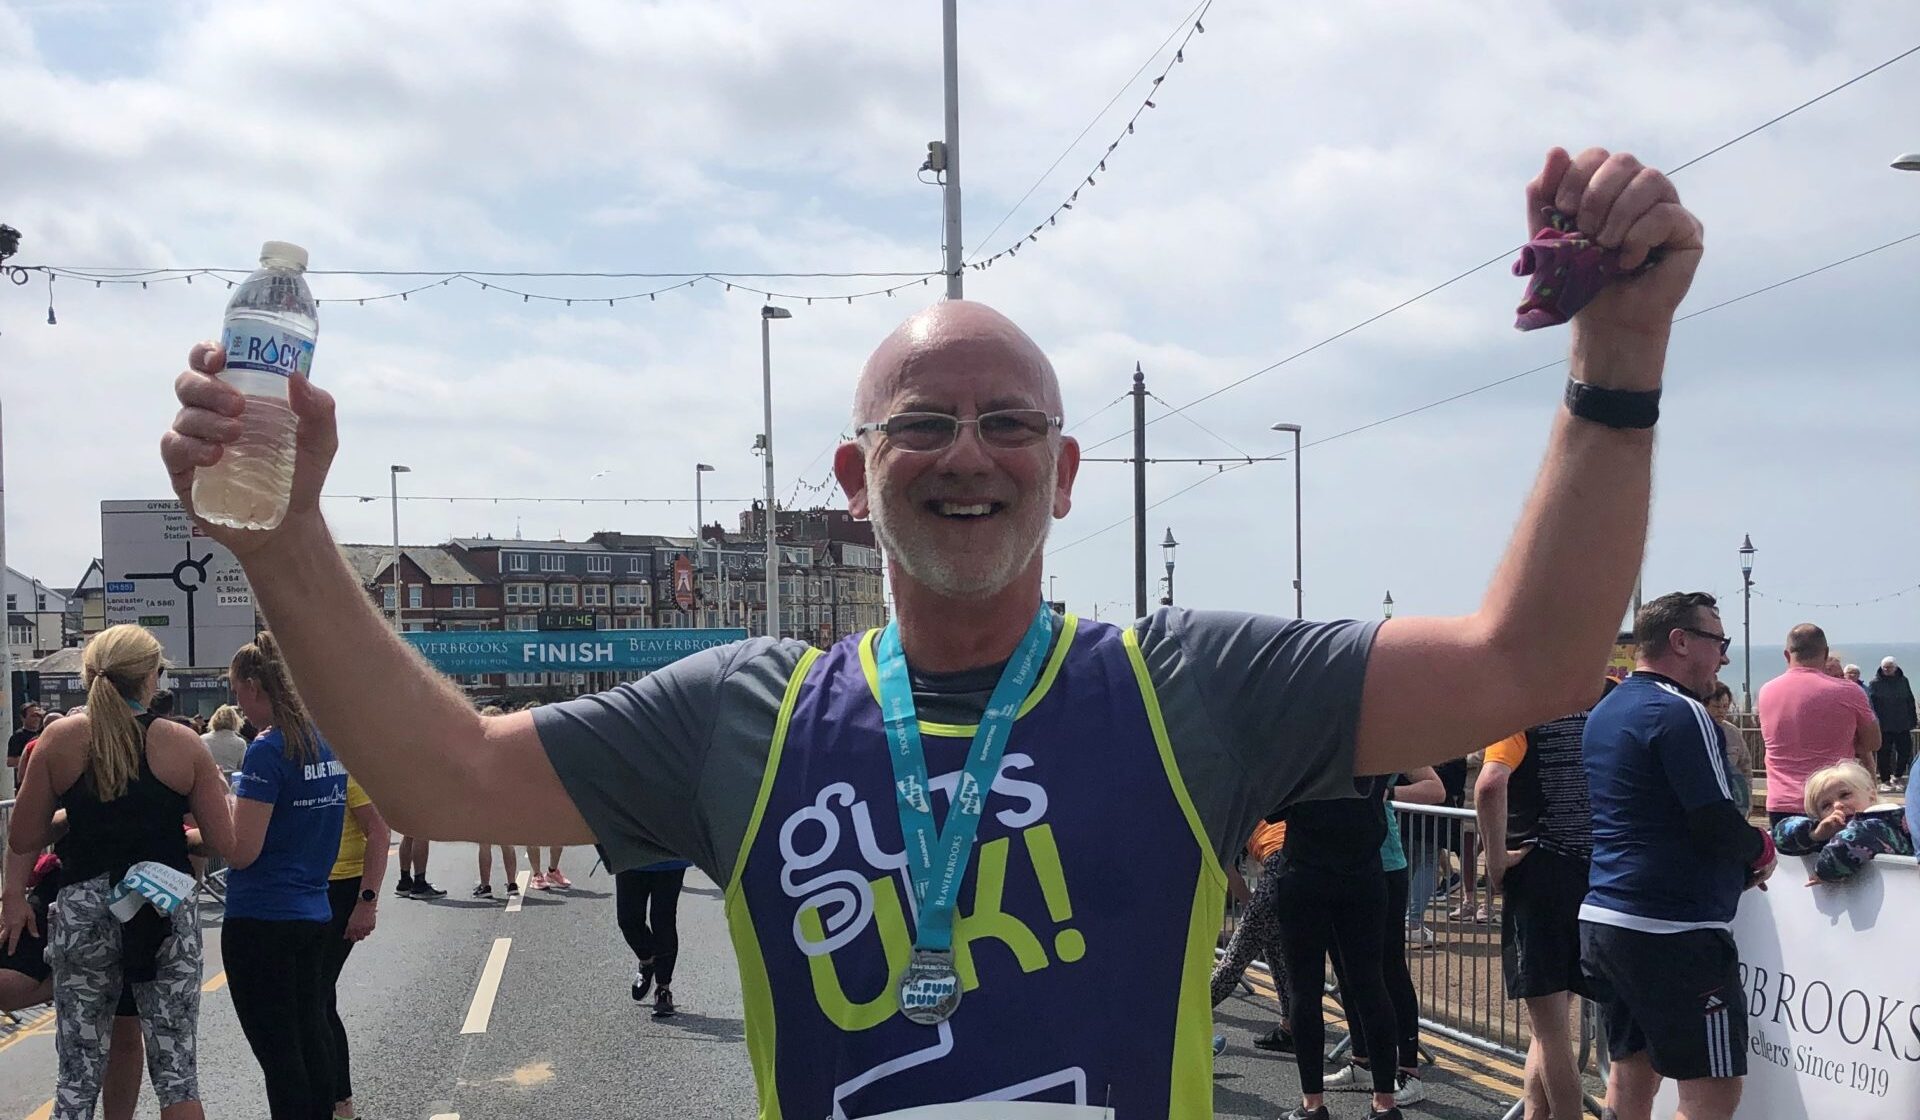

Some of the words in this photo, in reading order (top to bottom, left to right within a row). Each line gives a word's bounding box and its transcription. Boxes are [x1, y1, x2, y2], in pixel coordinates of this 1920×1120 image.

[247, 336, 301, 373] ROCK
[147, 502, 171, 510] GYNN
[227, 596, 249, 604] 5262
[523, 642, 614, 663] FINISH
[980, 724, 997, 762] SUPPORTING
[304, 761, 327, 781] BLUE
[935, 834, 963, 907] BEAVERBROOKS
[798, 823, 1087, 1032] UK!
[922, 982, 953, 994] FUN
[905, 993, 938, 1005] RUN
[1747, 1029, 1790, 1068] ellers
[1793, 1044, 1846, 1085] Since
[1849, 1060, 1890, 1099] 1919
